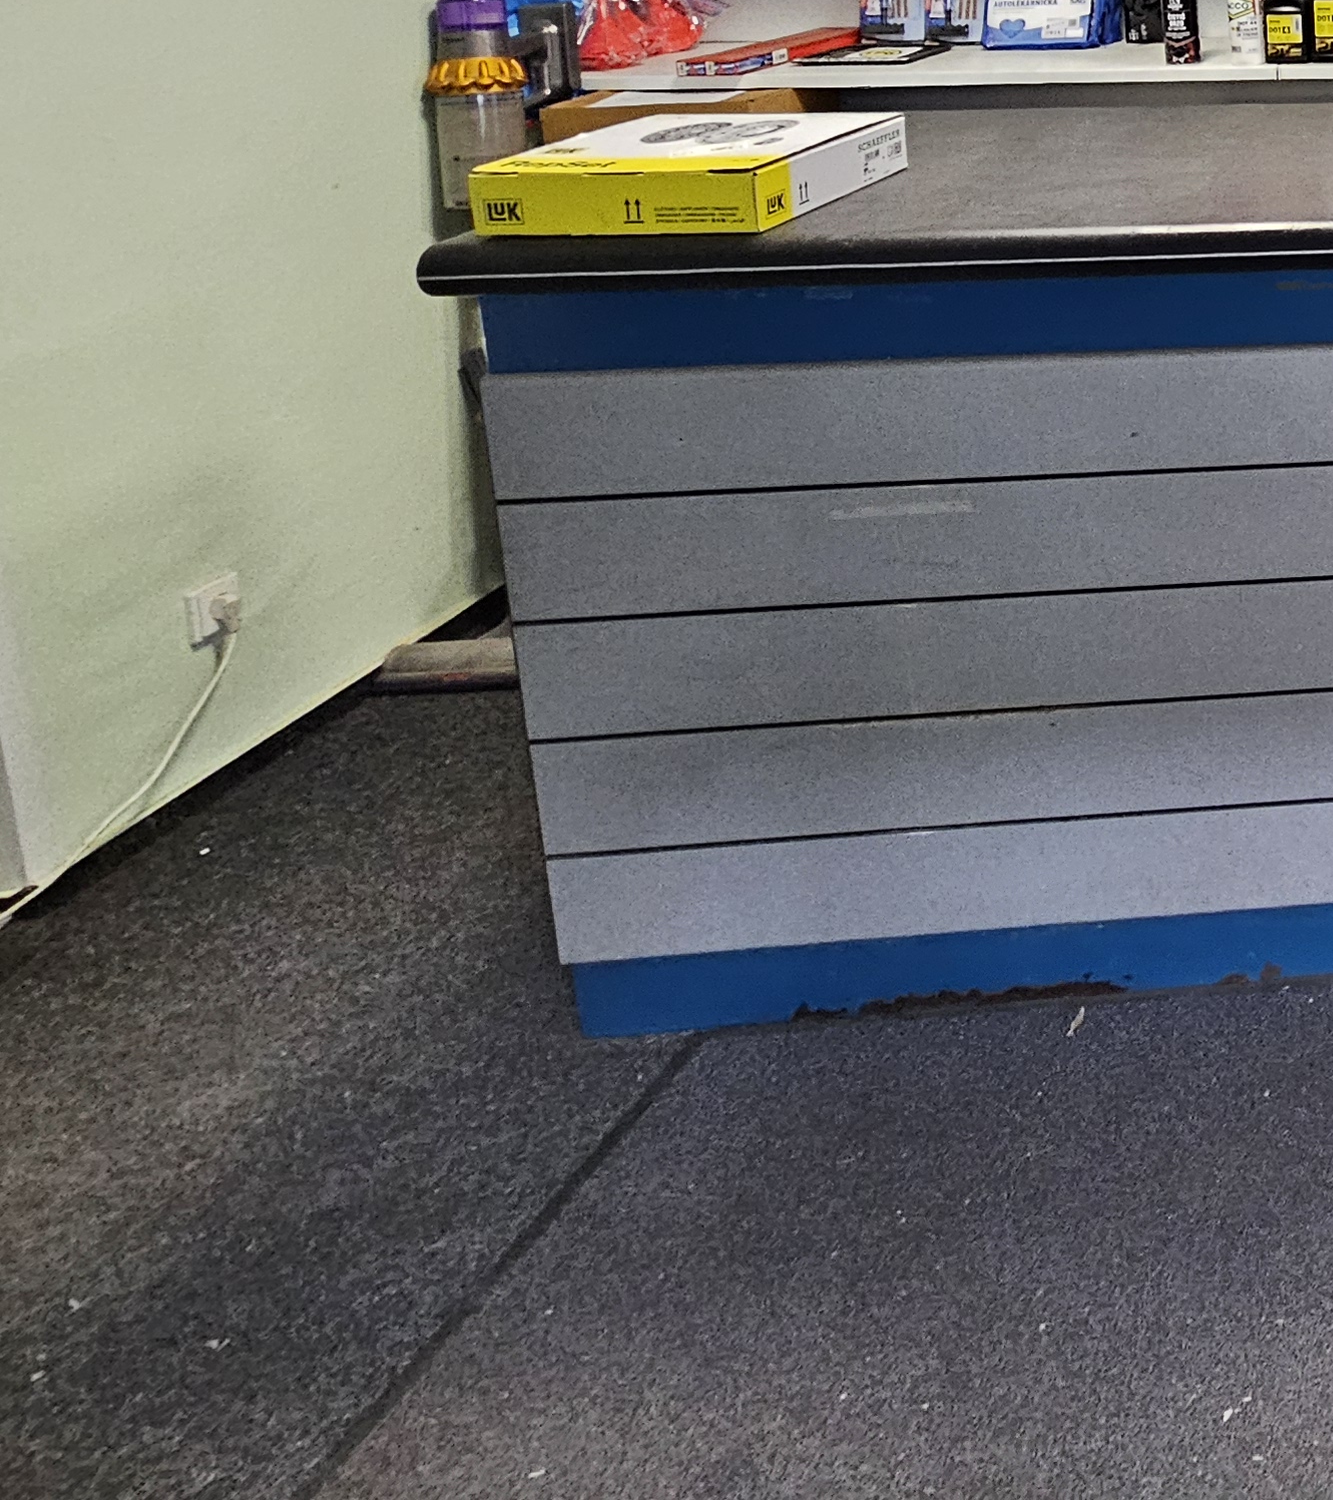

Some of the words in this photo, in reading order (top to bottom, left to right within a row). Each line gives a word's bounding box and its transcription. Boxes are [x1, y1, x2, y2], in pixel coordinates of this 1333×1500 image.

[1317, 14, 1331, 22] DOT
[1268, 26, 1282, 34] DOT
[857, 129, 901, 153] SCHAEFFLER
[487, 202, 521, 221] LUK
[766, 193, 785, 215] LUK
